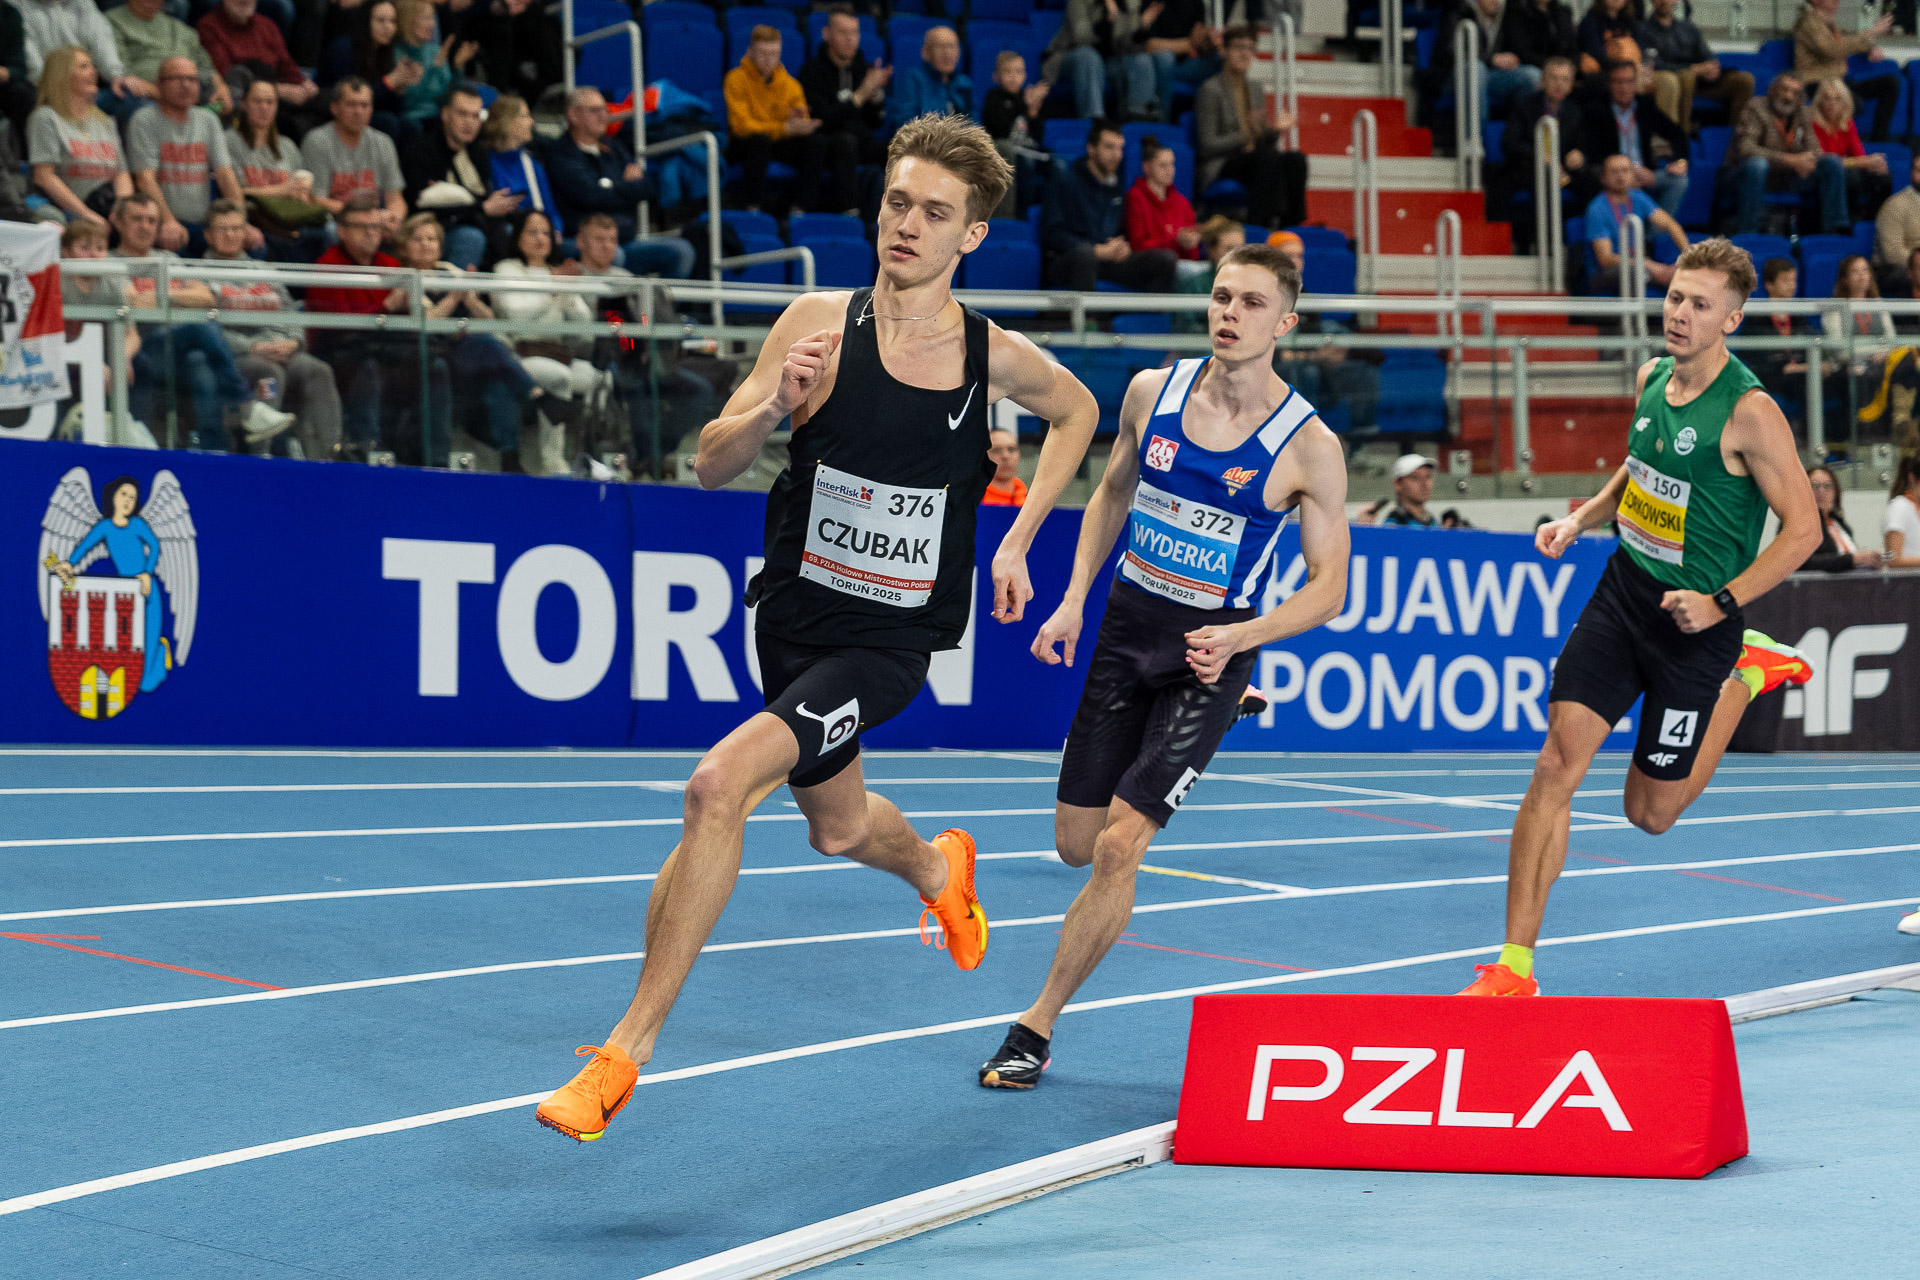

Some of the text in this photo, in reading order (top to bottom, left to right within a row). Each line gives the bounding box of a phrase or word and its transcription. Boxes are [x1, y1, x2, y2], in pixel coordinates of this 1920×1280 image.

[816, 478, 859, 499] InterRisk
[1654, 476, 1681, 499] 150
[888, 493, 934, 518] 376
[1191, 508, 1234, 536] 372
[818, 517, 931, 565] CZUBAK
[1134, 520, 1228, 576] WYDERKA
[820, 559, 836, 572] PZLA
[836, 565, 864, 579] Halowe
[863, 573, 909, 589] Mistrzostwa
[910, 581, 931, 590] Polski
[830, 575, 902, 602] TORUŃ 2025
[1141, 574, 1196, 600] TORUŃ 2025
[1203, 584, 1223, 595] Polski
[382, 537, 978, 706] TOR
[826, 714, 856, 745] 6
[1668, 715, 1689, 743] 4
[1246, 1044, 1633, 1132] PZLA
